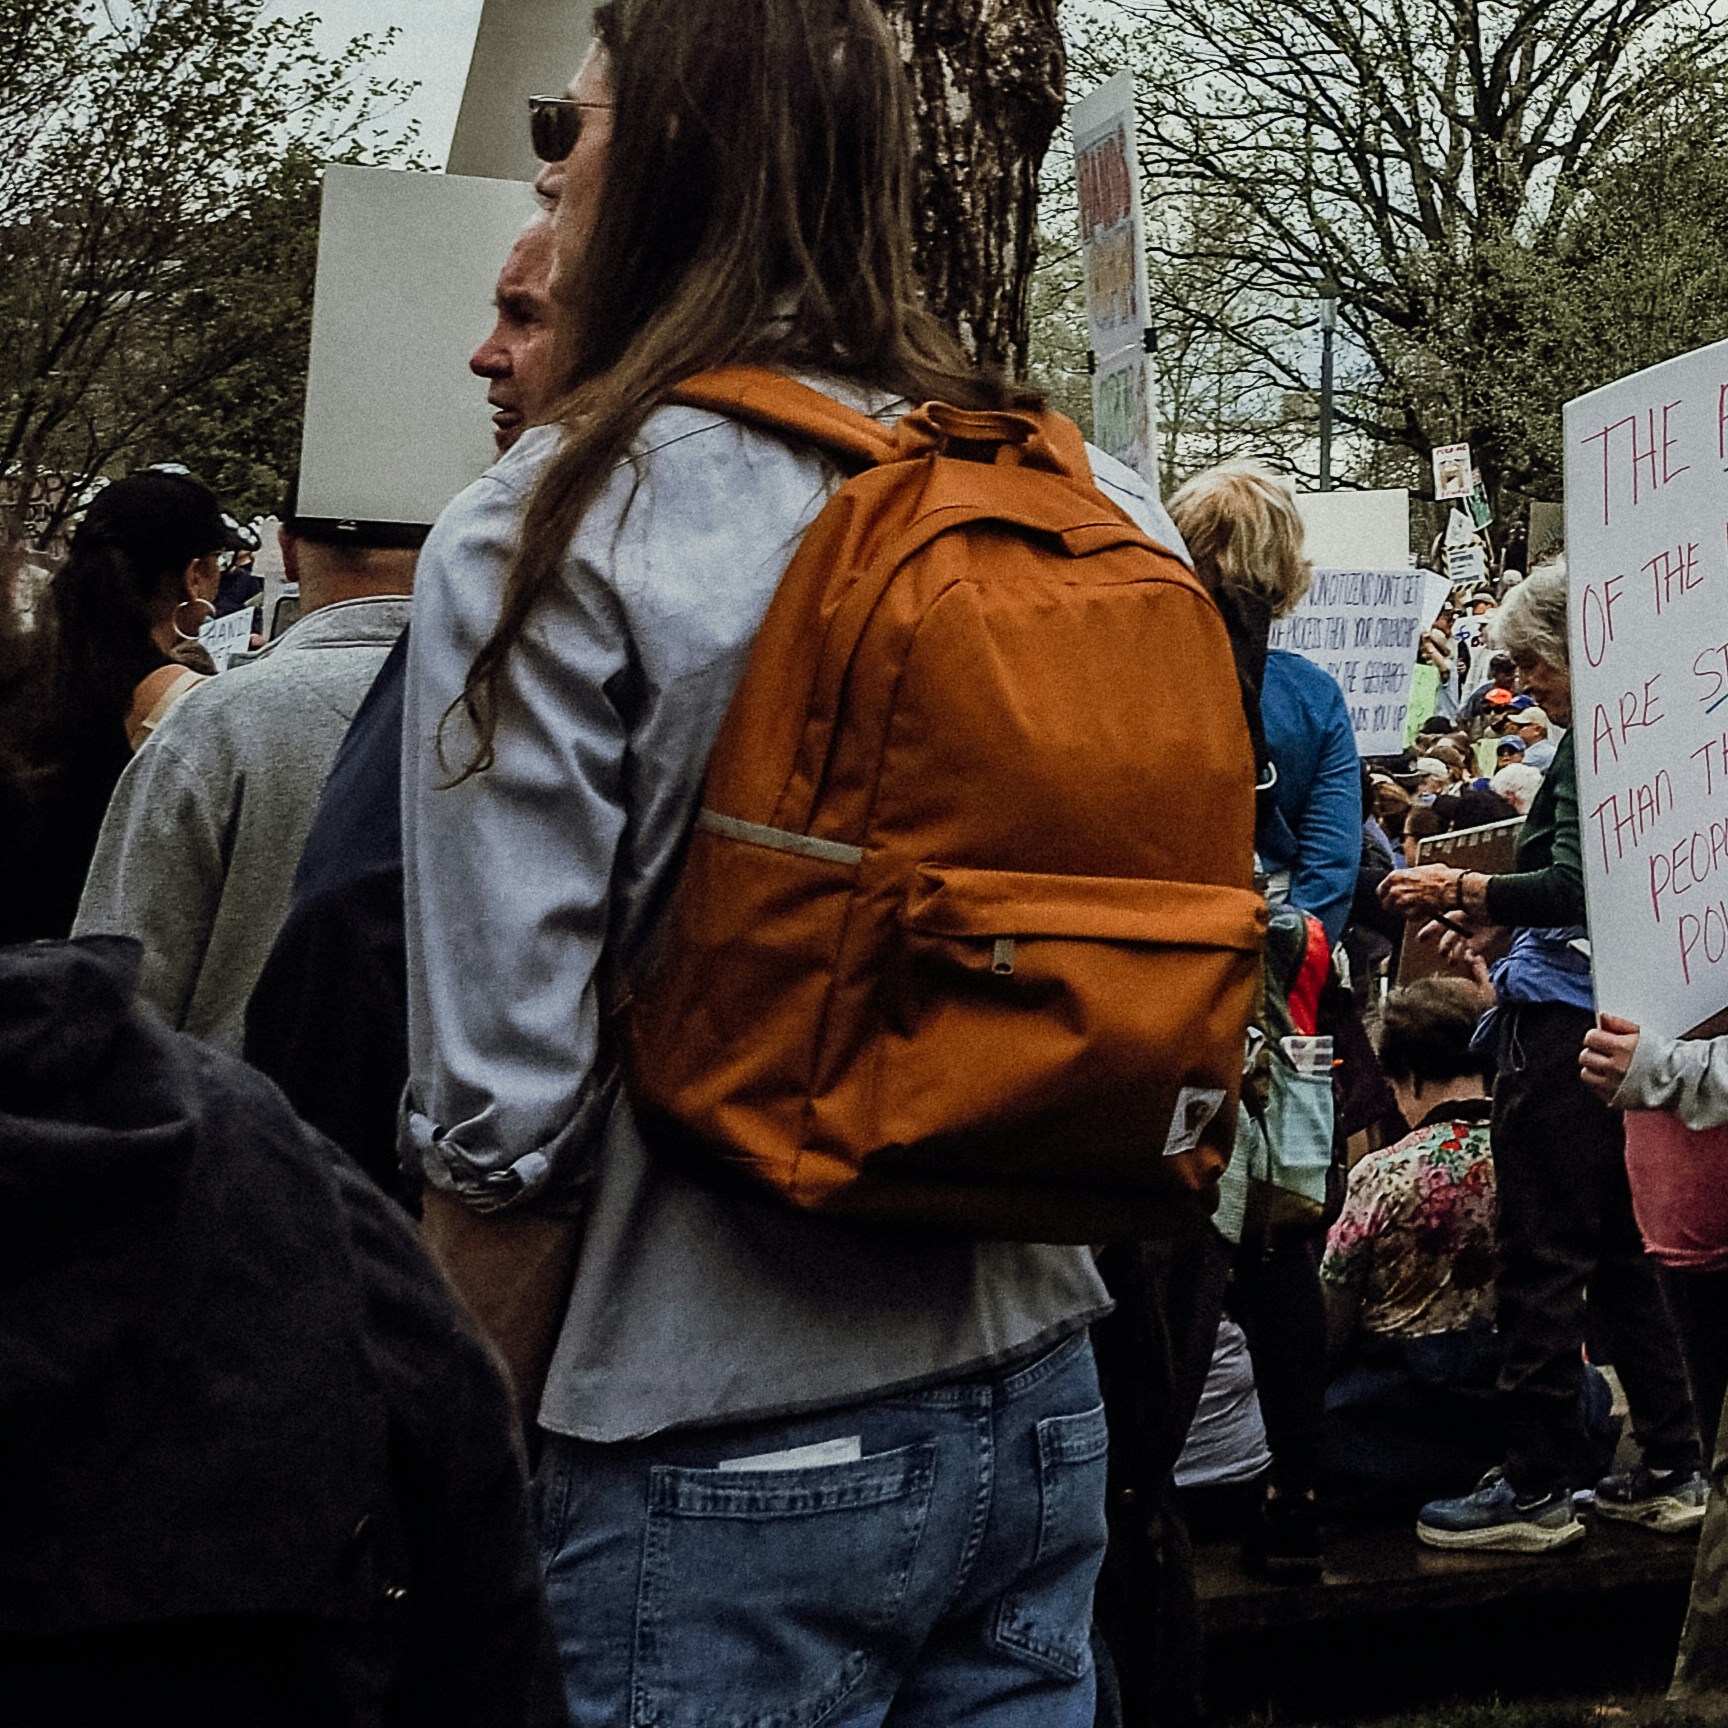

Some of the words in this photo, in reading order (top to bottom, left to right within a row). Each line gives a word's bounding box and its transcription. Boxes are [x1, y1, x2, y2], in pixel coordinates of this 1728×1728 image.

[1581, 400, 1690, 525] THE
[1583, 575, 1624, 667] OF
[1641, 543, 1703, 614] THE
[1594, 673, 1664, 775] ARE
